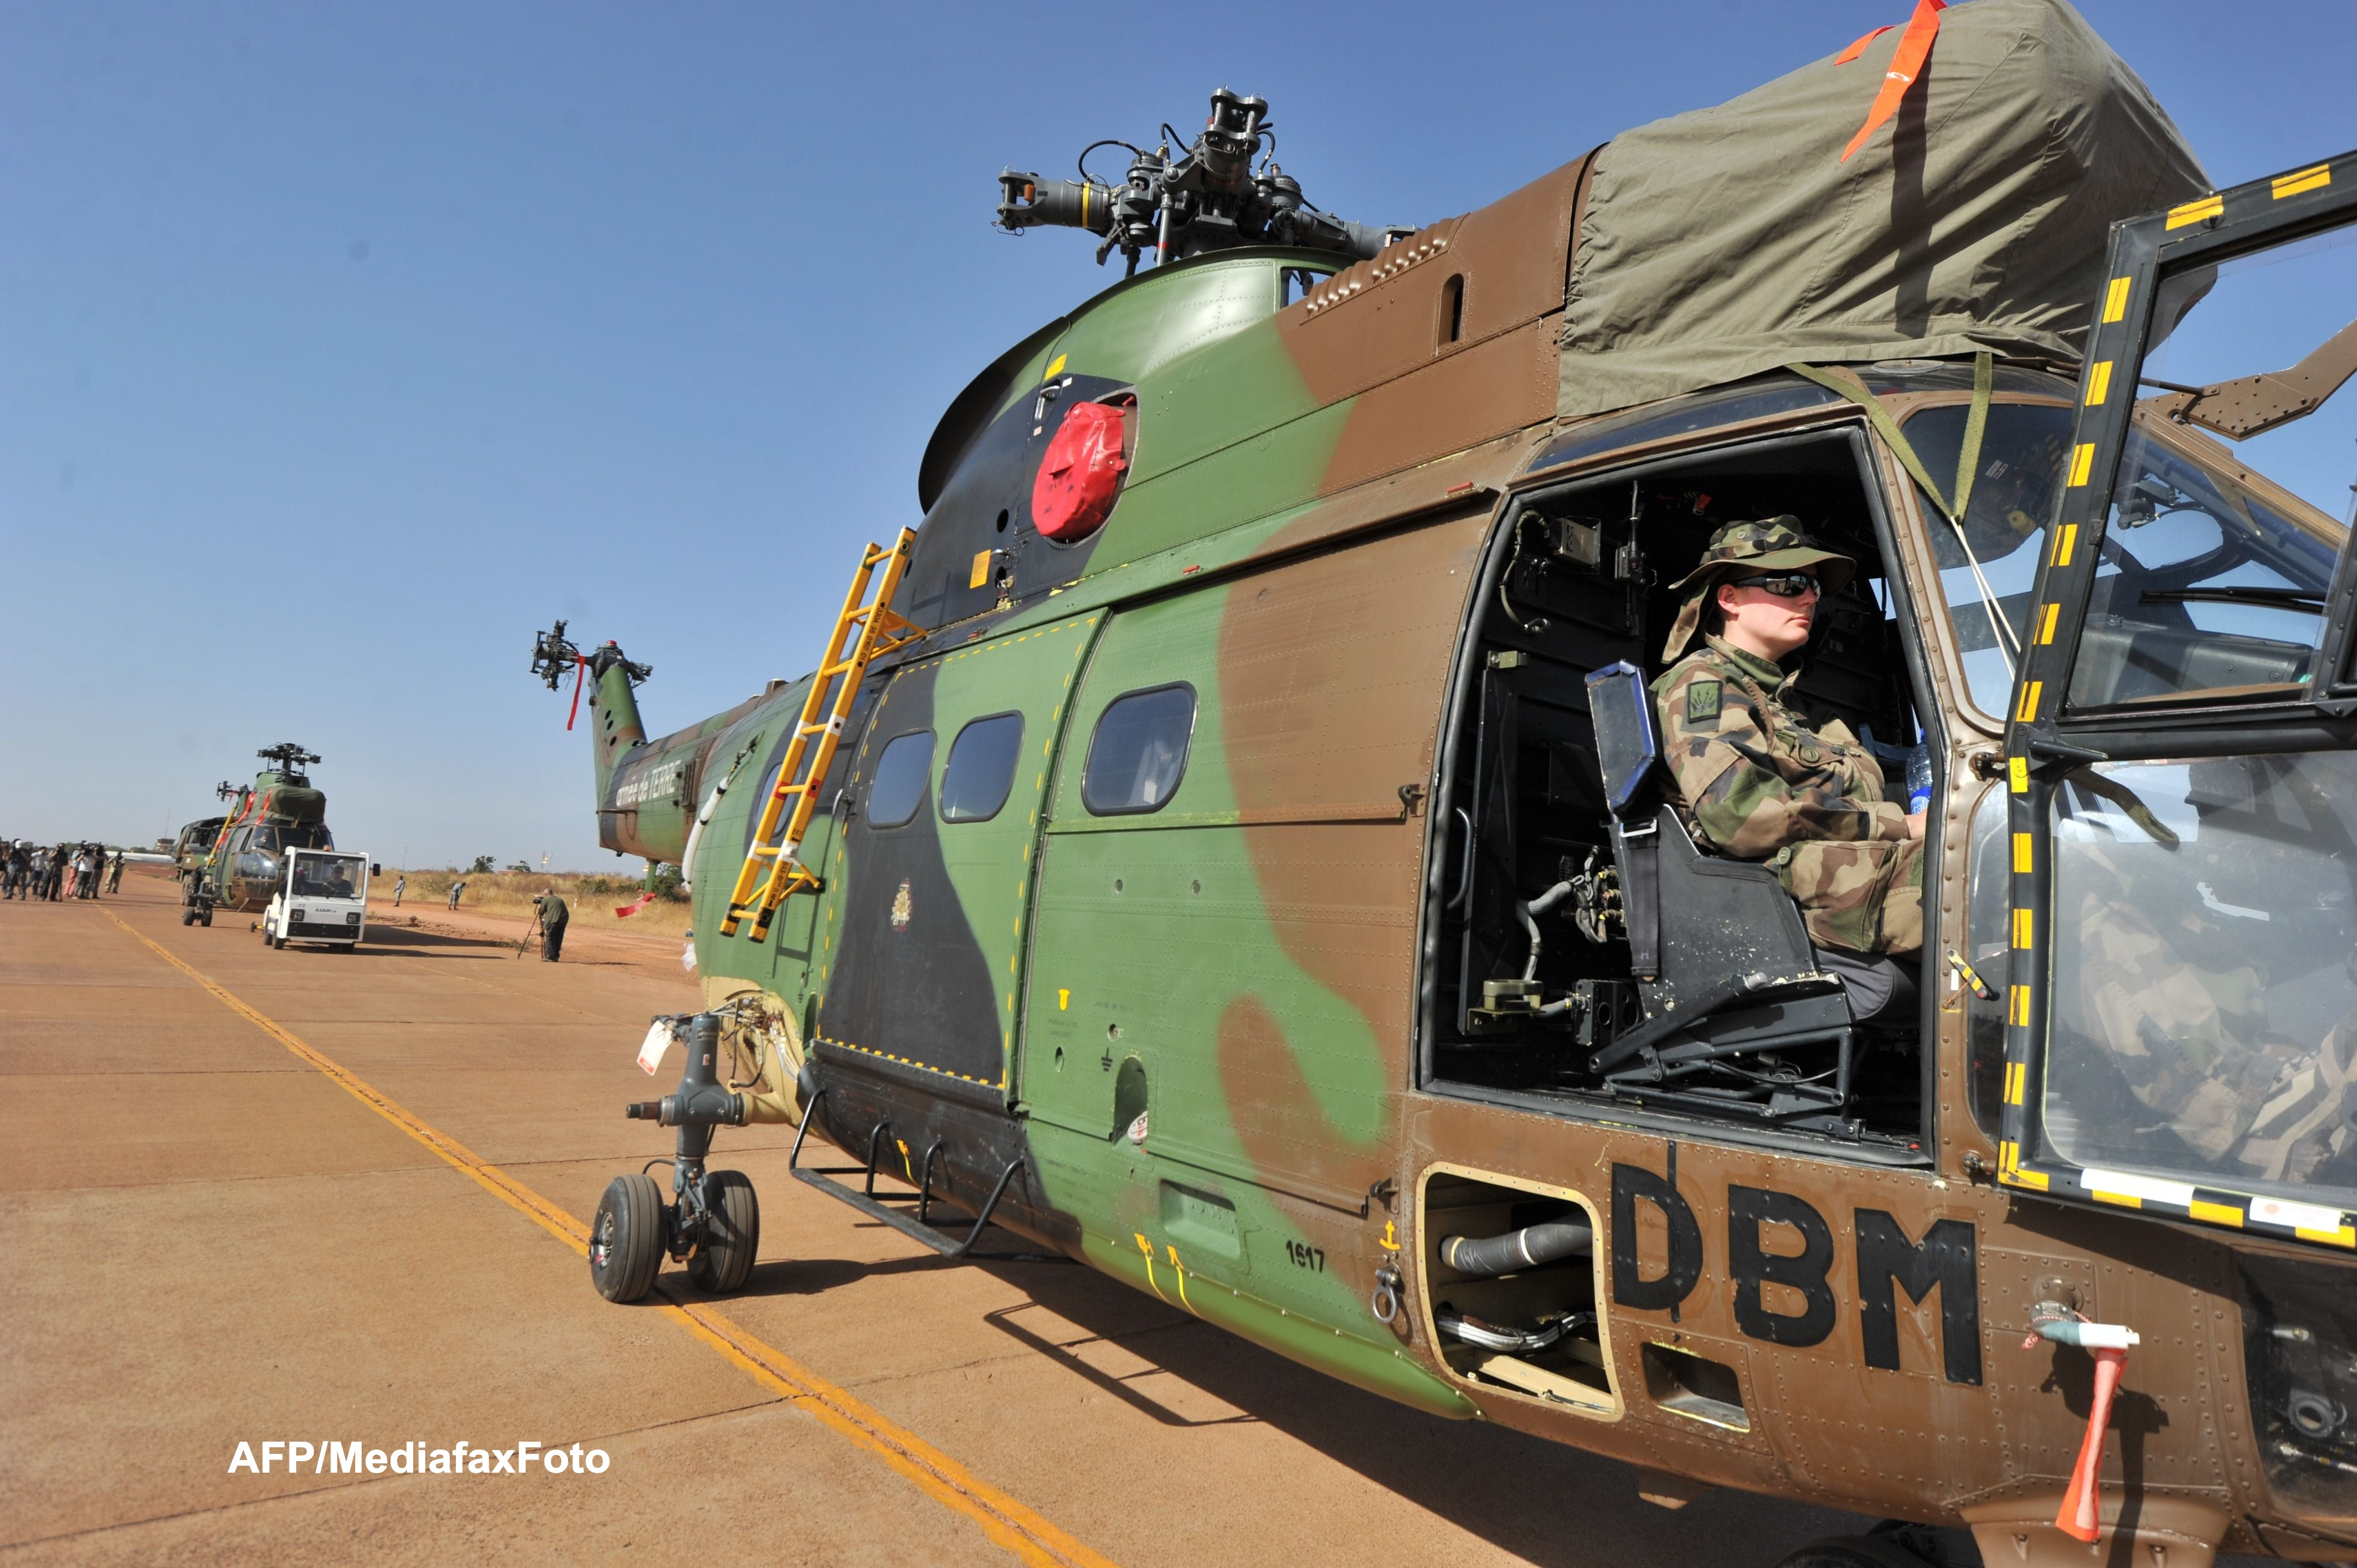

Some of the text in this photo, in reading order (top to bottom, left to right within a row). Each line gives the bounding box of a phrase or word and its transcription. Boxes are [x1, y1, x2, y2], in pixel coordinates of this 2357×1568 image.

[638, 771, 649, 802] de
[649, 759, 682, 800] TERRE
[1285, 1240, 1325, 1274] 1617
[1612, 1162, 1983, 1386] DBM
